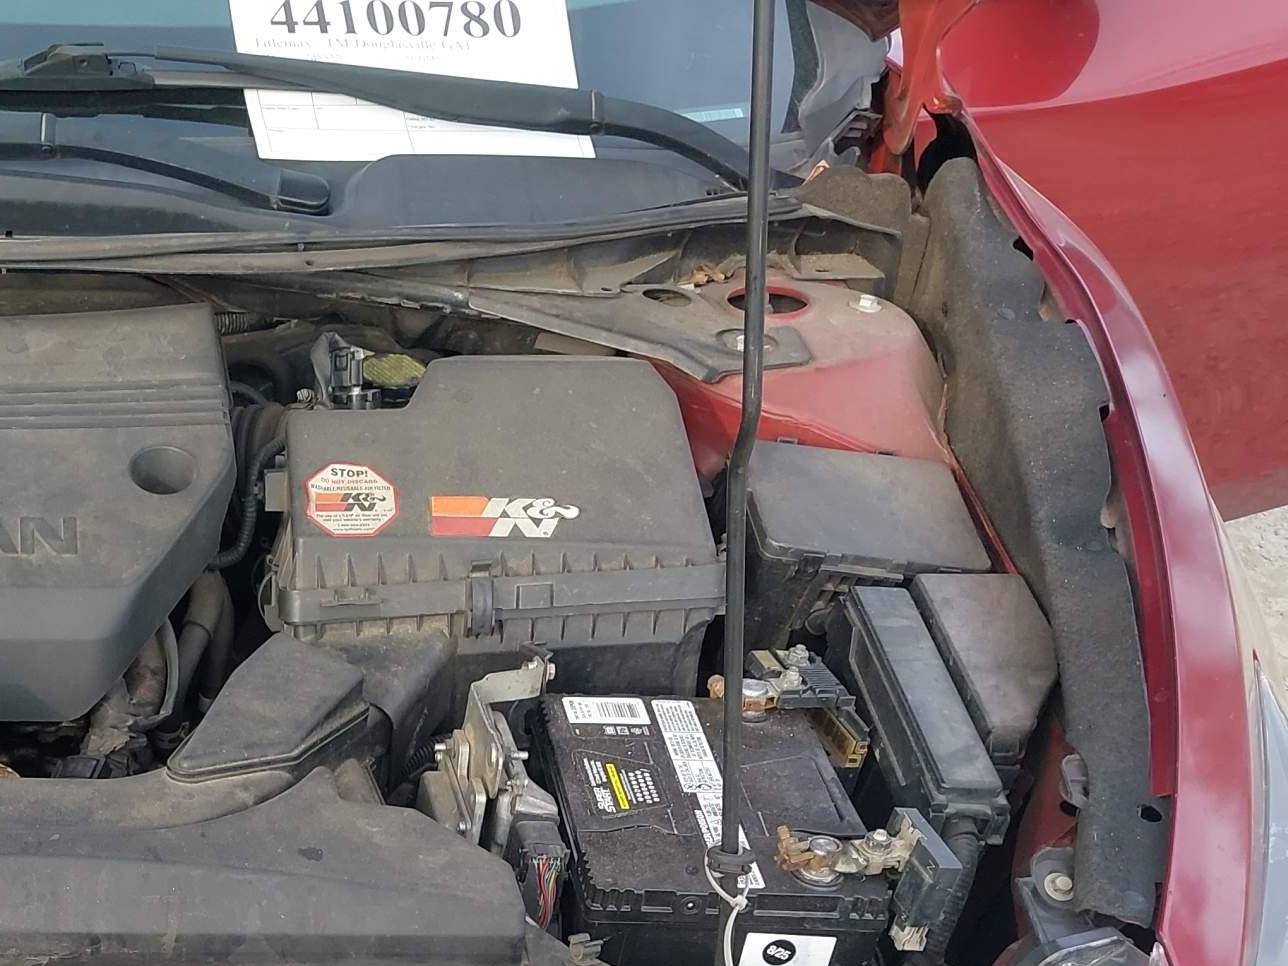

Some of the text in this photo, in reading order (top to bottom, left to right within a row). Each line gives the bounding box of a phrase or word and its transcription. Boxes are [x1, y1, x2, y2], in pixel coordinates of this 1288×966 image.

[270, 0, 522, 38] 44100780
[331, 468, 368, 478] STOP!
[767, 944, 791, 960] 8/25
